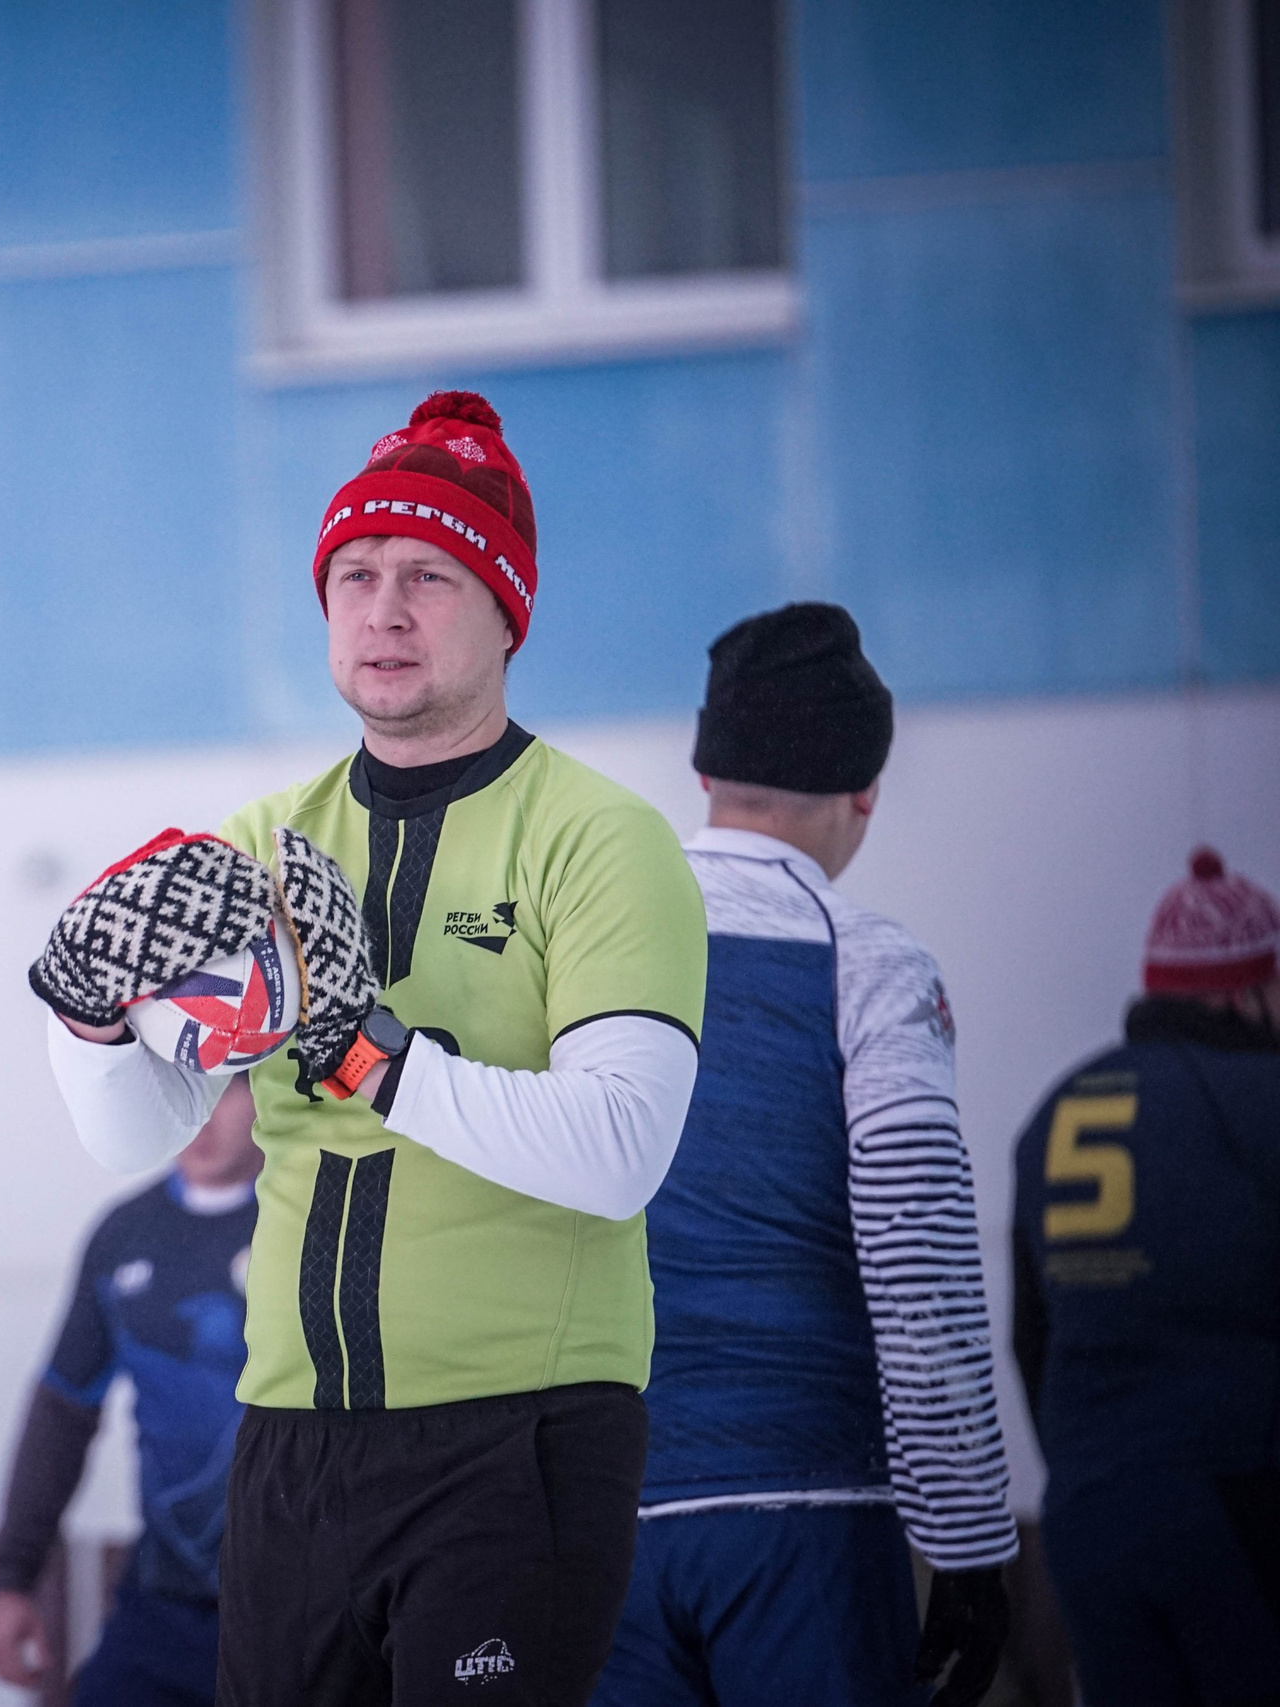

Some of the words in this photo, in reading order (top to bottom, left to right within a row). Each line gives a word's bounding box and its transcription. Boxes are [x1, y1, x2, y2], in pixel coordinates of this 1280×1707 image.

[363, 499, 488, 552] РЕГБИ
[494, 554, 533, 613] МОС
[443, 923, 489, 936] РОССИИ
[446, 911, 482, 923] РЕГБИ
[272, 966, 282, 994] AGES
[1043, 1094, 1138, 1242] 5
